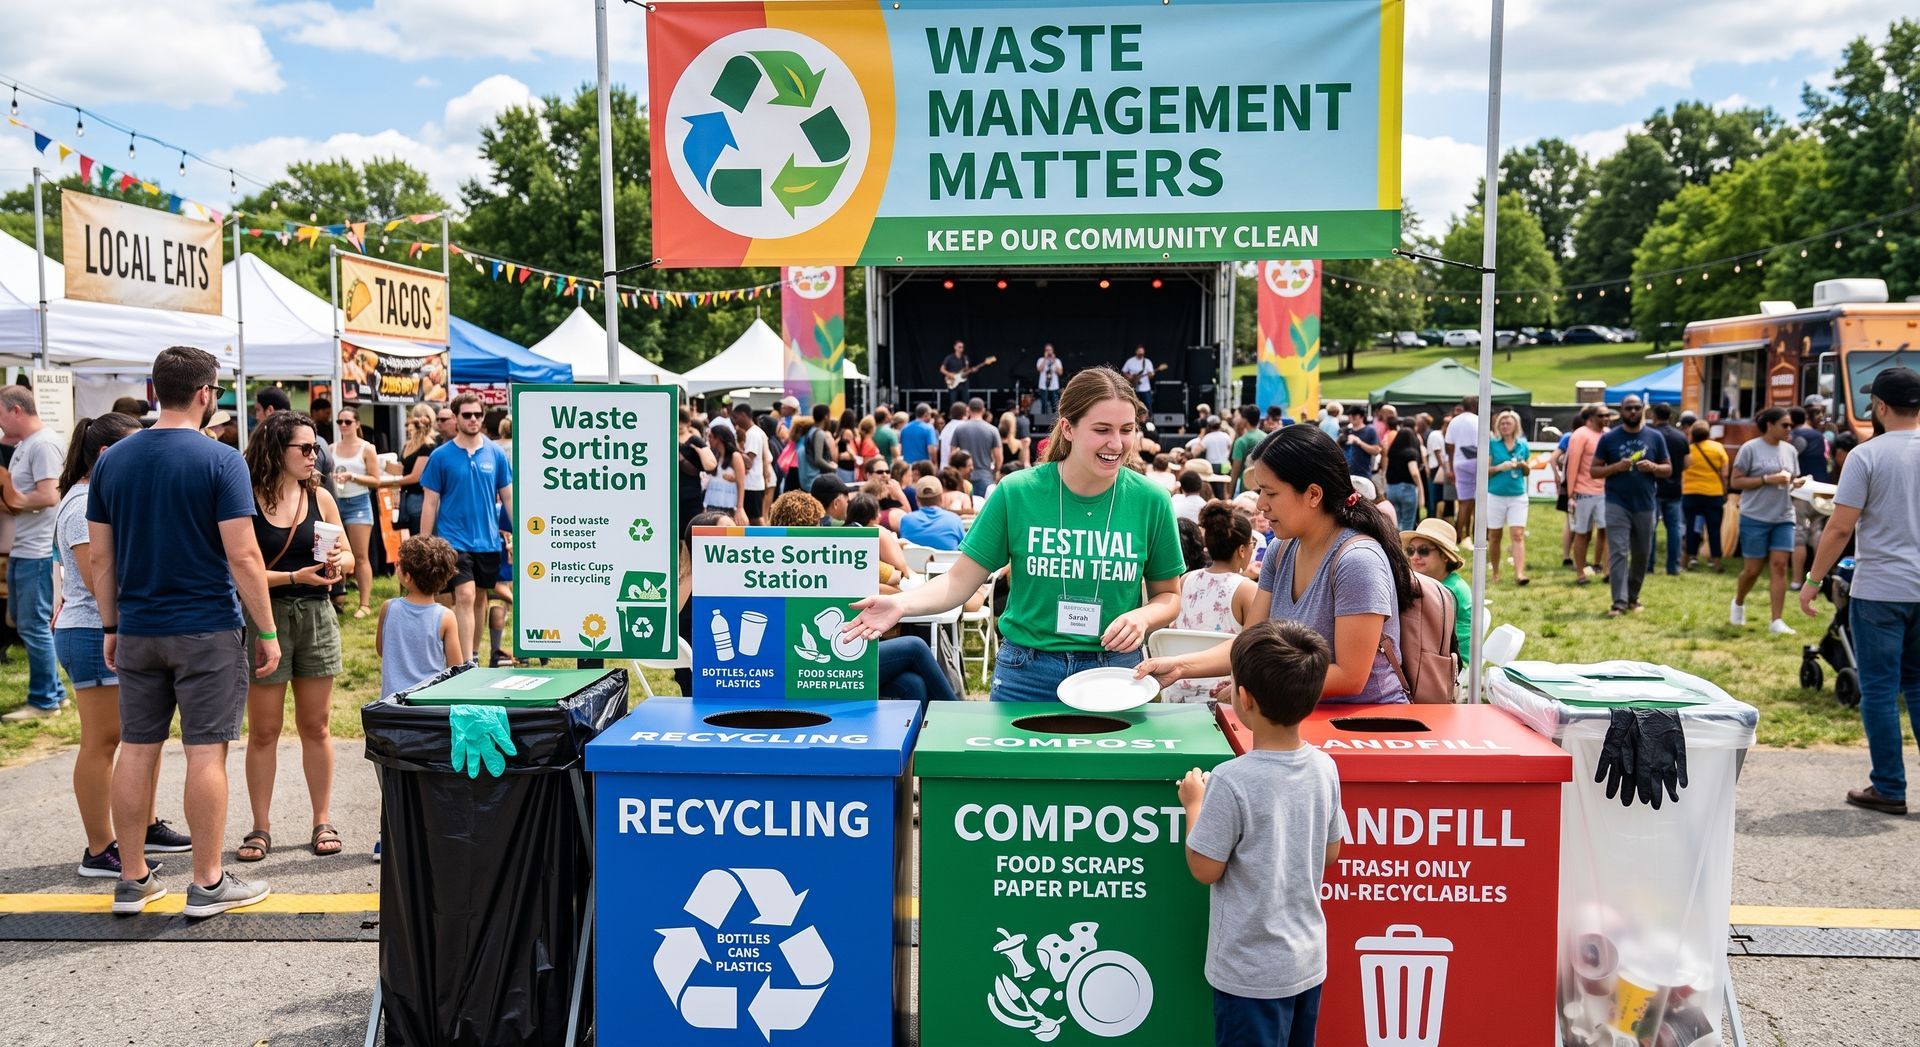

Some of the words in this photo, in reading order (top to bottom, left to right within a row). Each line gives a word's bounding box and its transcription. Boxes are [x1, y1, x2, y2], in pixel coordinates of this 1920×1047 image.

[924, 23, 1143, 74] WASTE
[928, 82, 1352, 137] MANAGEMENT
[929, 147, 1224, 201] MATTERS
[927, 229, 994, 252] KEEP
[1000, 228, 1058, 251] OUR
[1064, 226, 1229, 250] COMMUNITY
[1233, 224, 1319, 248] CLEAN
[85, 224, 156, 283] LOCAL
[163, 239, 209, 291] EATS
[375, 276, 432, 330] TACOS
[550, 405, 638, 430] Waste
[541, 434, 649, 467] Sorting
[542, 465, 647, 491] Station
[532, 519, 540, 531] 1
[550, 515, 578, 526] Food
[580, 516, 610, 526] waste
[550, 527, 561, 538] in
[563, 529, 597, 538] seaser
[1027, 525, 1138, 559] FESTIVAL
[550, 540, 597, 552] compost
[550, 560, 585, 571] Plastic
[587, 561, 614, 573] Cups
[703, 544, 775, 564] Waste
[781, 544, 869, 570] Sorting
[532, 565, 540, 576] 2
[743, 568, 828, 589] Station
[1026, 556, 1085, 579] GREEN
[1090, 559, 1138, 582] TEAM
[550, 572, 561, 583] in
[563, 572, 612, 586] recycling
[1068, 613, 1090, 622] Sarah
[525, 628, 562, 640] WM
[702, 668, 747, 680] BOTTLES,
[748, 668, 775, 678] CANS
[797, 669, 825, 679] FOOD
[826, 669, 864, 679] SCRAPS
[715, 679, 761, 689] PLASTICS
[796, 680, 828, 690] PAPER
[829, 680, 865, 690] PLATES
[629, 731, 869, 744] RECYCLING
[964, 736, 1182, 750] COMPOST
[618, 797, 869, 838] RECYCLING
[954, 803, 1187, 844] COMPOST
[996, 855, 1056, 874] FOOD
[1061, 856, 1145, 875] SCRAPS
[1337, 859, 1409, 878] TRASH
[1415, 860, 1472, 878] ONLY
[994, 879, 1063, 898] PAPER
[1068, 880, 1147, 899] PLATES
[1319, 882, 1508, 903] ON-RECYCLABLES
[717, 933, 771, 945] BOTTLES
[727, 947, 760, 958] CANS
[716, 961, 773, 973] PLASTICS
